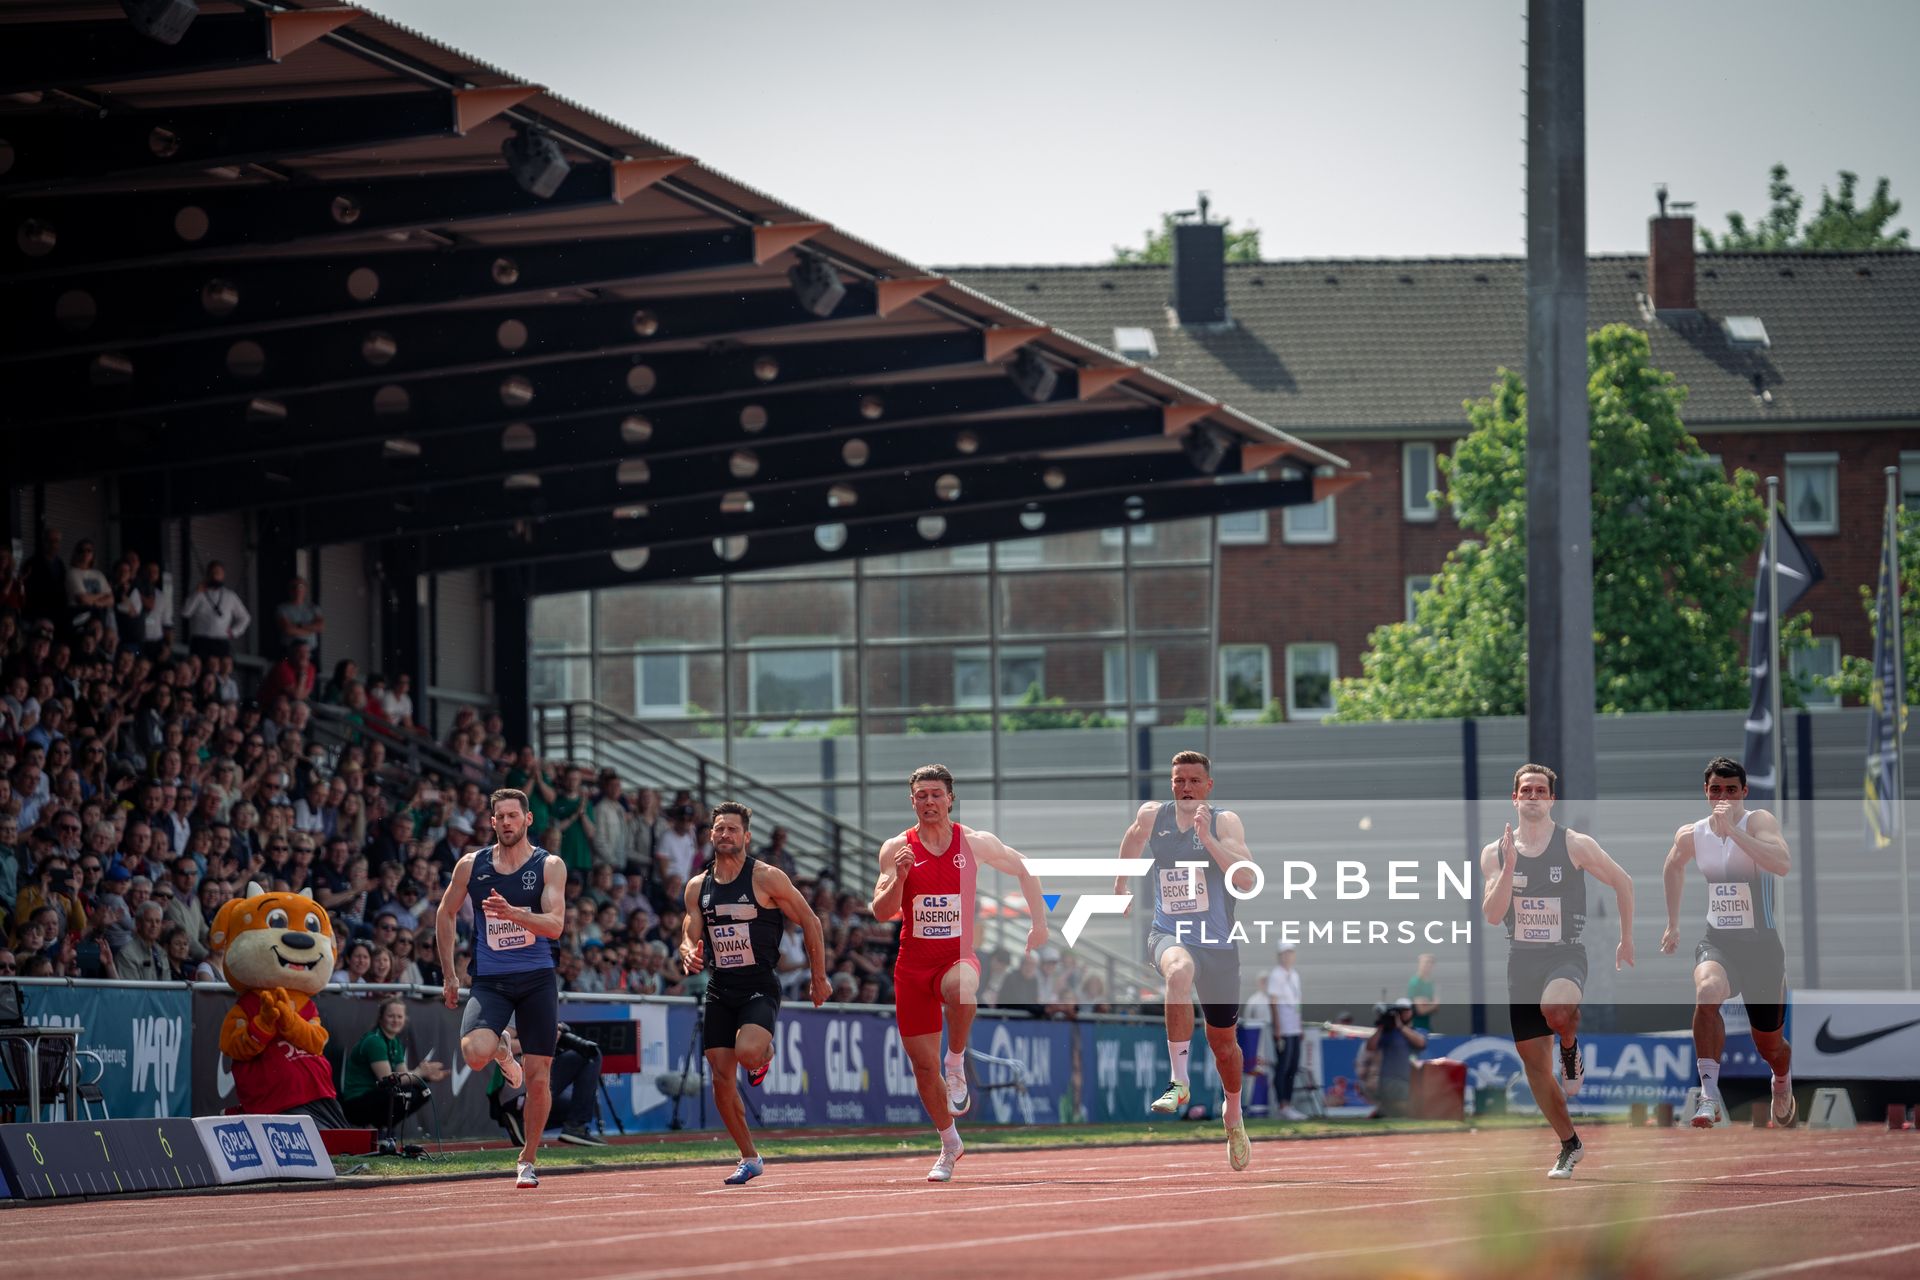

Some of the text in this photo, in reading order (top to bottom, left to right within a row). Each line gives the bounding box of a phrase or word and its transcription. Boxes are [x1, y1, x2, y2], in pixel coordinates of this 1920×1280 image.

[1166, 870, 1189, 882] GLS
[1163, 883, 1205, 897] BECKES
[1716, 885, 1737, 896] GLS
[923, 897, 948, 907] GLS
[1521, 900, 1545, 910] GLS
[1711, 900, 1749, 912] BASTIEN
[915, 910, 960, 922] LASERICH
[714, 927, 735, 938] GLS
[713, 939, 749, 952] NOWAK
[824, 1019, 864, 1092] GLS
[883, 1025, 918, 1096] GL
[1824, 1093, 1837, 1120] 7
[26, 1127, 172, 1165] 8 7 6
[229, 1131, 254, 1153] PLAN
[281, 1131, 309, 1151] PLAN
